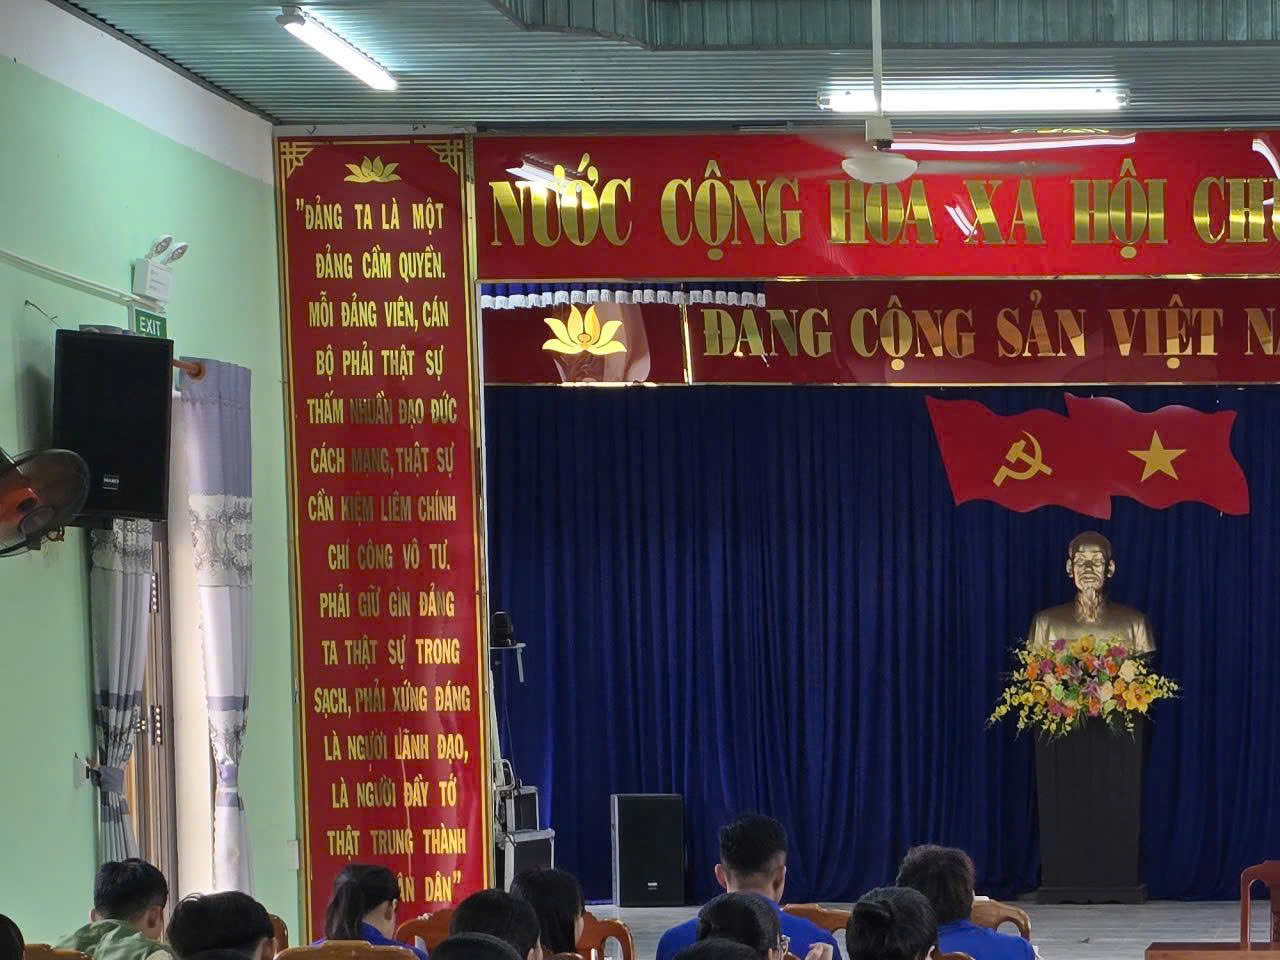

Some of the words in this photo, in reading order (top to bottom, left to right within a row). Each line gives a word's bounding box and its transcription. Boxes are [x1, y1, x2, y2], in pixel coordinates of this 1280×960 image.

[355, 203, 372, 230] TA
[381, 197, 400, 230] LÀ
[413, 197, 444, 235] MỘT
[489, 152, 632, 247] NƯỚC
[660, 159, 802, 261] CỘNG
[1071, 158, 1168, 259] HỘI
[316, 244, 353, 279] ĐẢNG
[362, 245, 391, 279] CẦM
[139, 317, 161, 336] EXIT
[309, 290, 333, 327] MỖI
[341, 292, 377, 327] ĐẢNG
[384, 292, 419, 332] VIÊN,
[422, 290, 449, 327] CÁN
[850, 295, 975, 371] CỘNG
[997, 289, 1087, 358] SẢN
[1107, 294, 1223, 370] VIỆT
[316, 344, 334, 382] BỘ
[343, 341, 373, 376] PHẢI
[381, 344, 415, 381] THẬT
[426, 345, 444, 381] SỰ
[307, 390, 343, 424] THẤM
[431, 390, 457, 424] ĐỨC
[310, 442, 344, 473] CÁCH
[396, 443, 429, 477] THẬT
[437, 443, 455, 477] SỰ
[308, 488, 334, 521] CẦN
[418, 490, 457, 521] CHÍNH
[358, 538, 393, 570] CÔNG
[403, 538, 420, 569] VÔ
[320, 584, 350, 618] PHẢI
[419, 582, 455, 617] ĐẢNG
[322, 640, 338, 665] TA
[345, 634, 377, 670] THẬT
[388, 634, 405, 670] SỰ
[416, 638, 460, 664] TRONG
[355, 678, 386, 713] PHẢI
[393, 679, 427, 712] XỨNG
[435, 680, 470, 711] ĐÁNG
[324, 730, 341, 761] LÀ
[394, 727, 429, 760] LÃNH
[436, 733, 468, 764] ĐẠO,
[332, 777, 349, 808] LÀ
[404, 773, 429, 808] ĐẦY
[327, 825, 360, 861] THẬT
[370, 828, 414, 854] TRUNG
[423, 823, 466, 854] THÀNH
